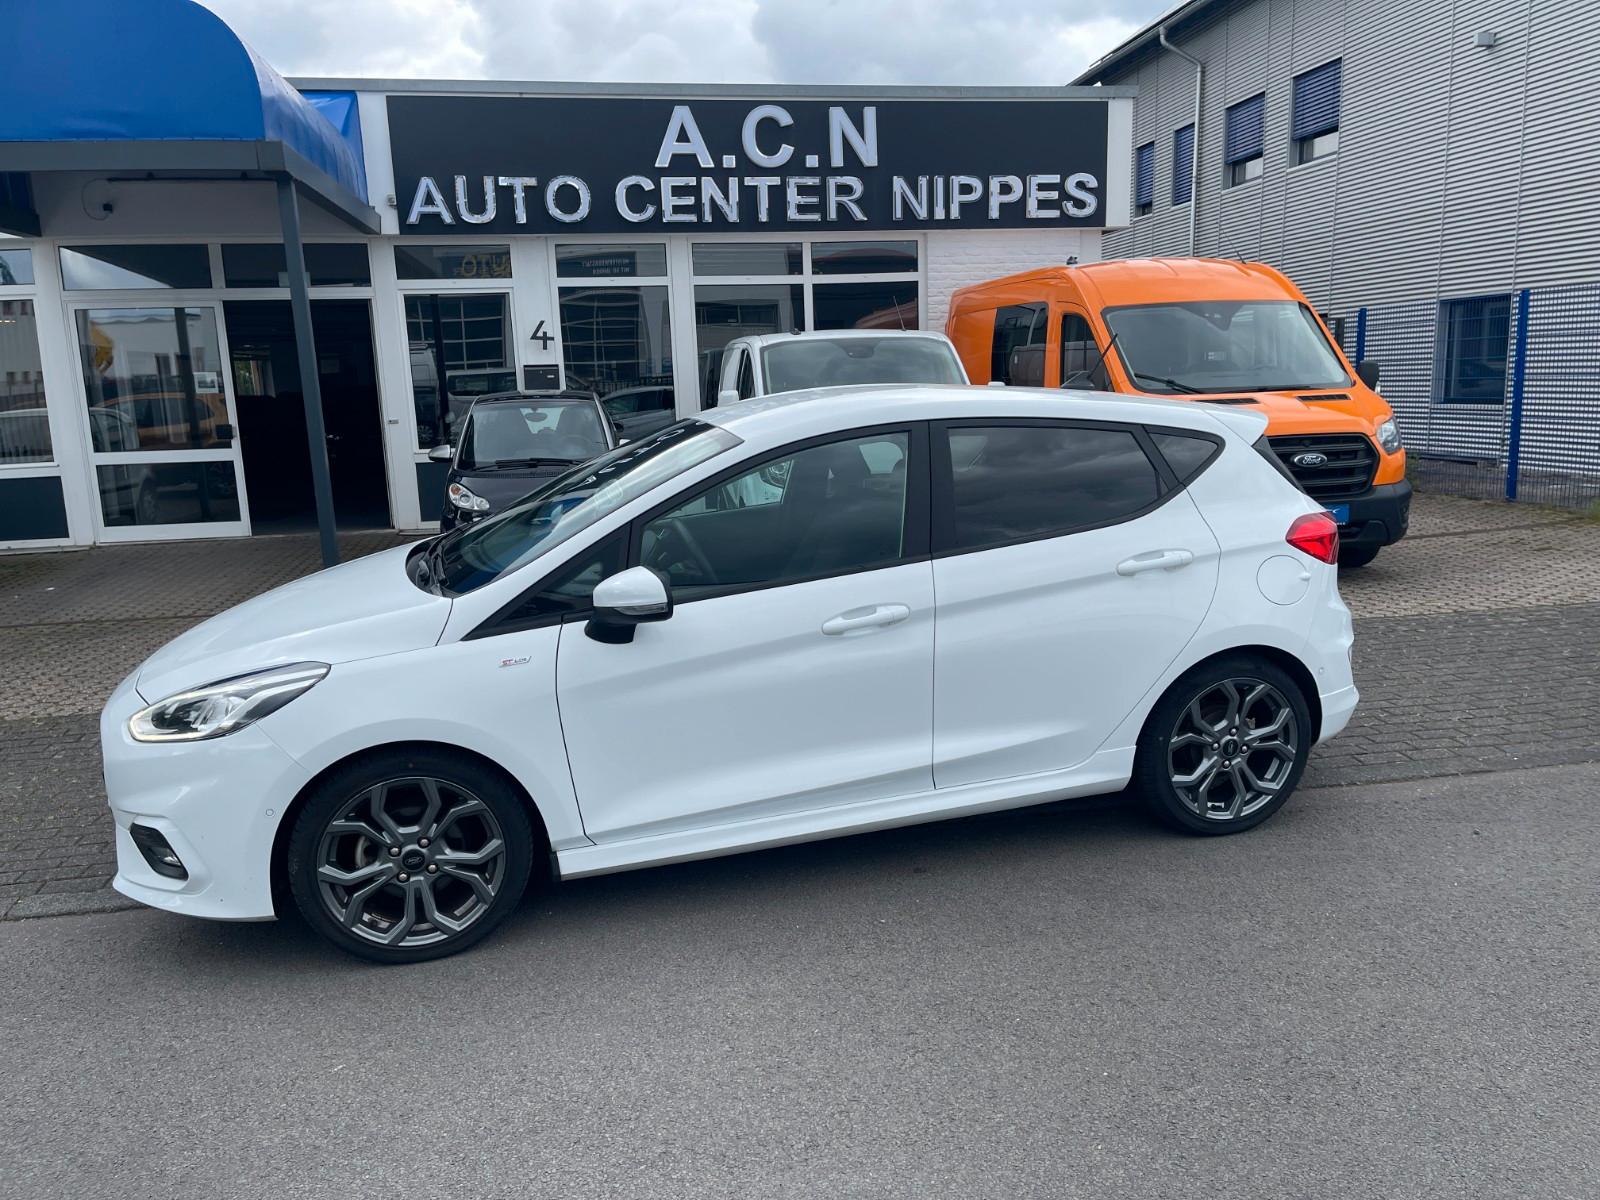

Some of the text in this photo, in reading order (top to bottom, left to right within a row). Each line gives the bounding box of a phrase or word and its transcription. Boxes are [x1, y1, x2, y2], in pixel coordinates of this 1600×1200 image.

[655, 104, 878, 168] A.C.N
[405, 172, 1098, 224] AUTO CENTER NIPPES
[530, 320, 554, 350] 4
